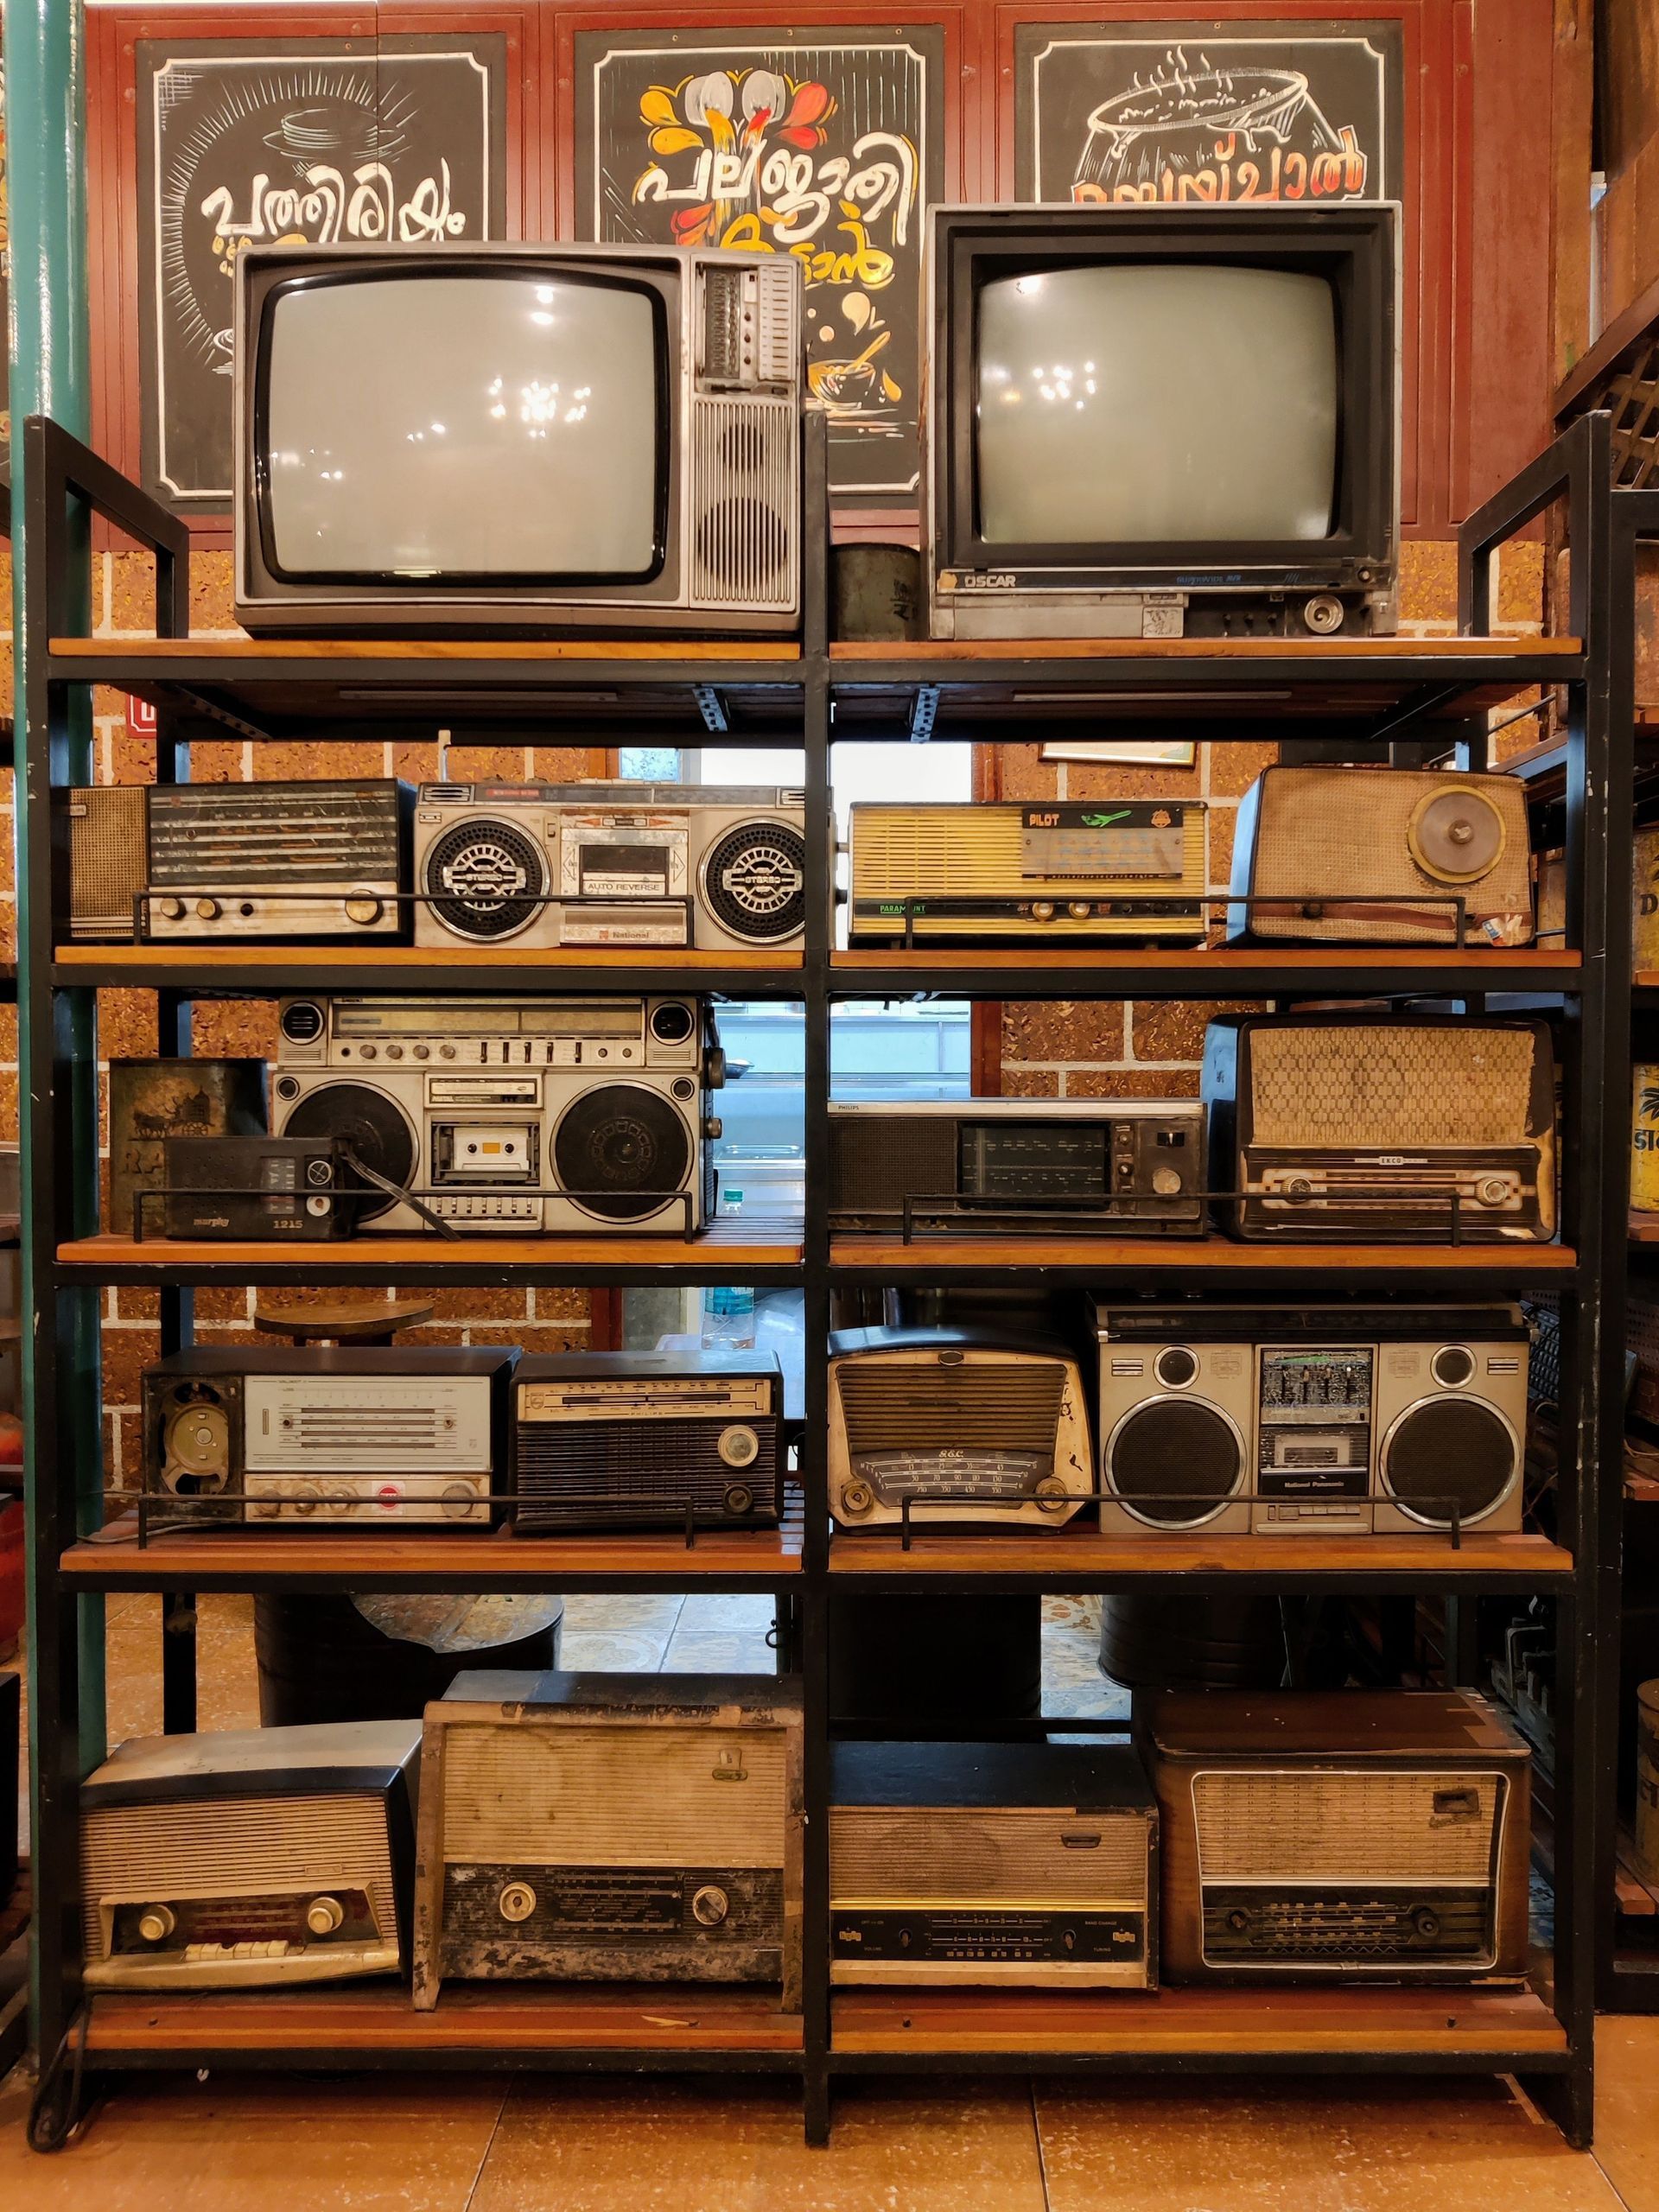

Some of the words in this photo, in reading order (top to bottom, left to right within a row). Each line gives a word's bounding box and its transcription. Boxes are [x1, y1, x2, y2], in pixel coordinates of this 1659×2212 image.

[964, 575, 1016, 588] OSCAR
[1029, 813, 1060, 827] PILOT
[613, 931, 650, 939] National
[273, 1219, 303, 1229] 1215
